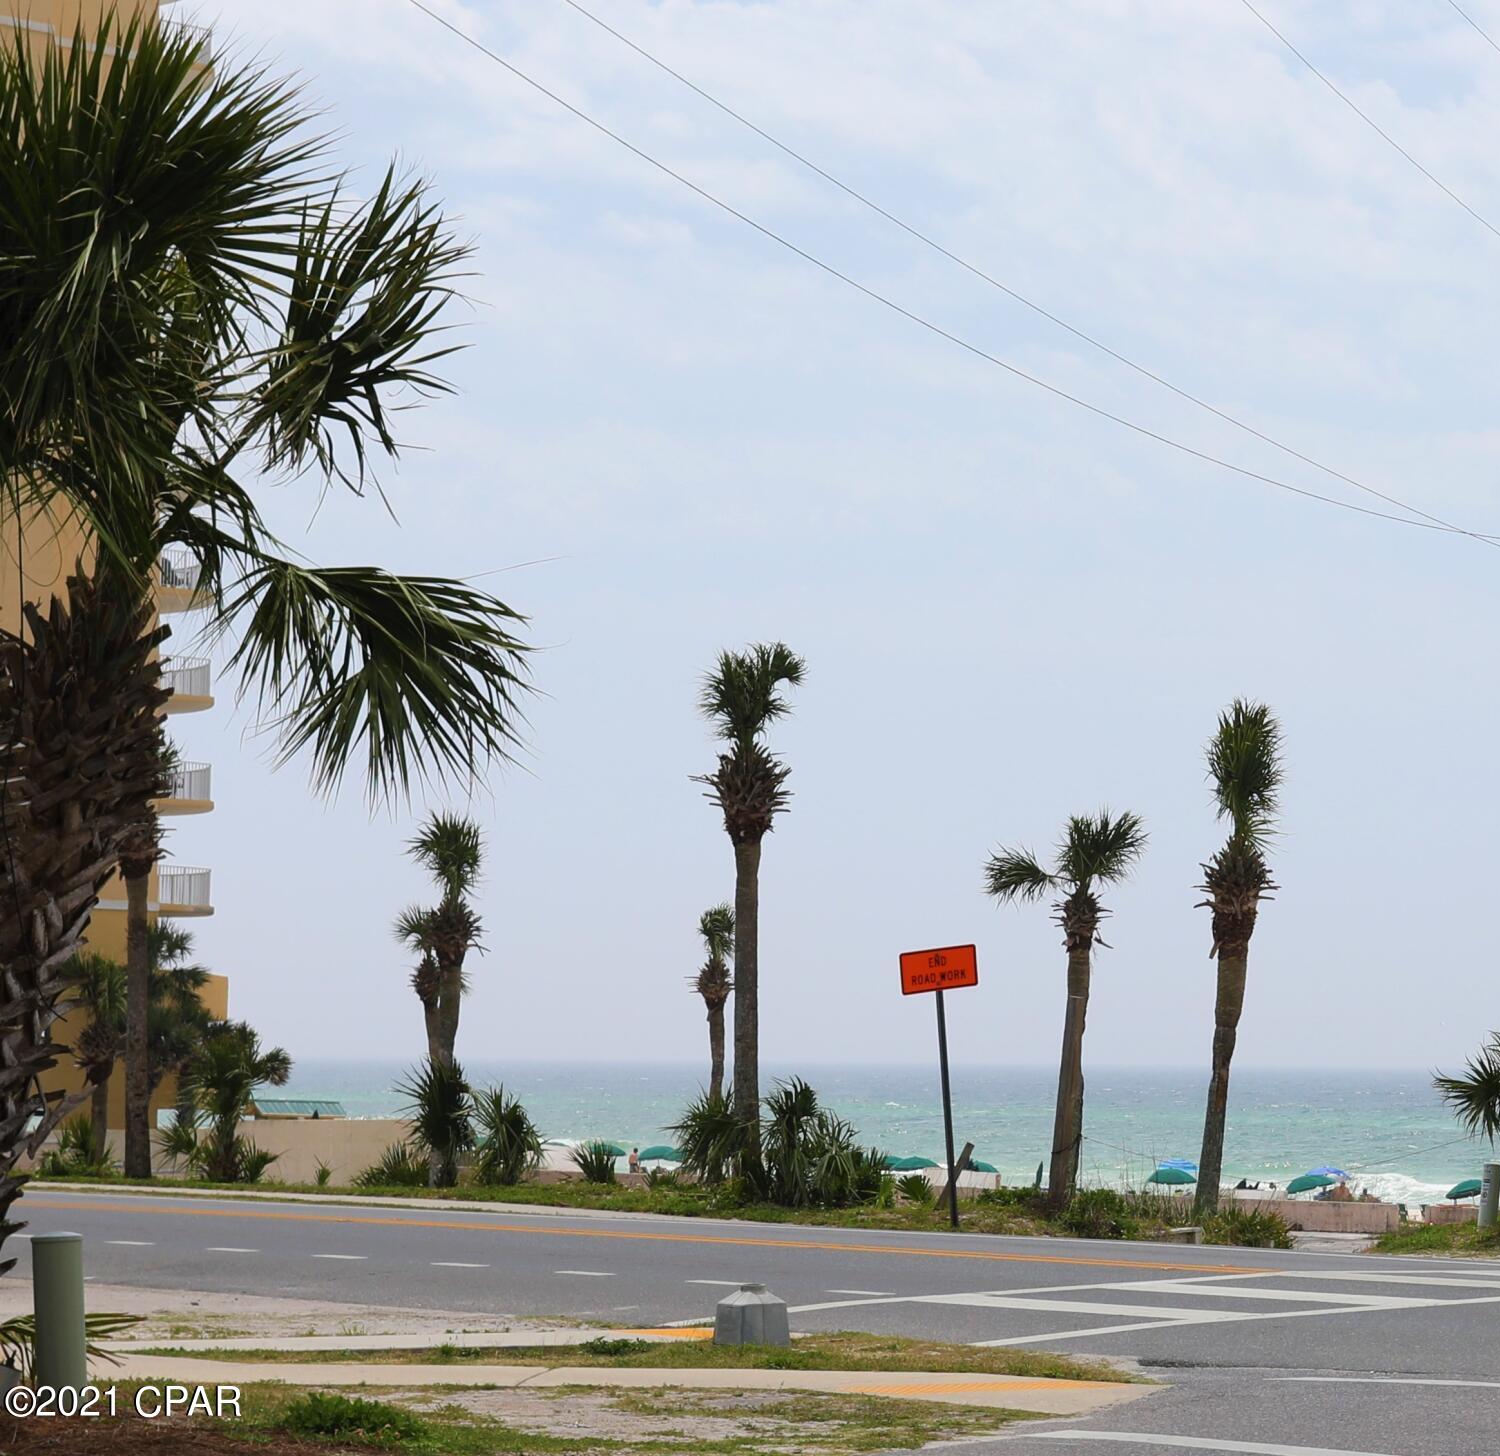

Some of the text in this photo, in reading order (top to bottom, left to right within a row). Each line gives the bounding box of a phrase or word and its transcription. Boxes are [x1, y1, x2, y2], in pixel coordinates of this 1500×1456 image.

[928, 956, 947, 968] END
[911, 969, 967, 985] ROAD WORK
